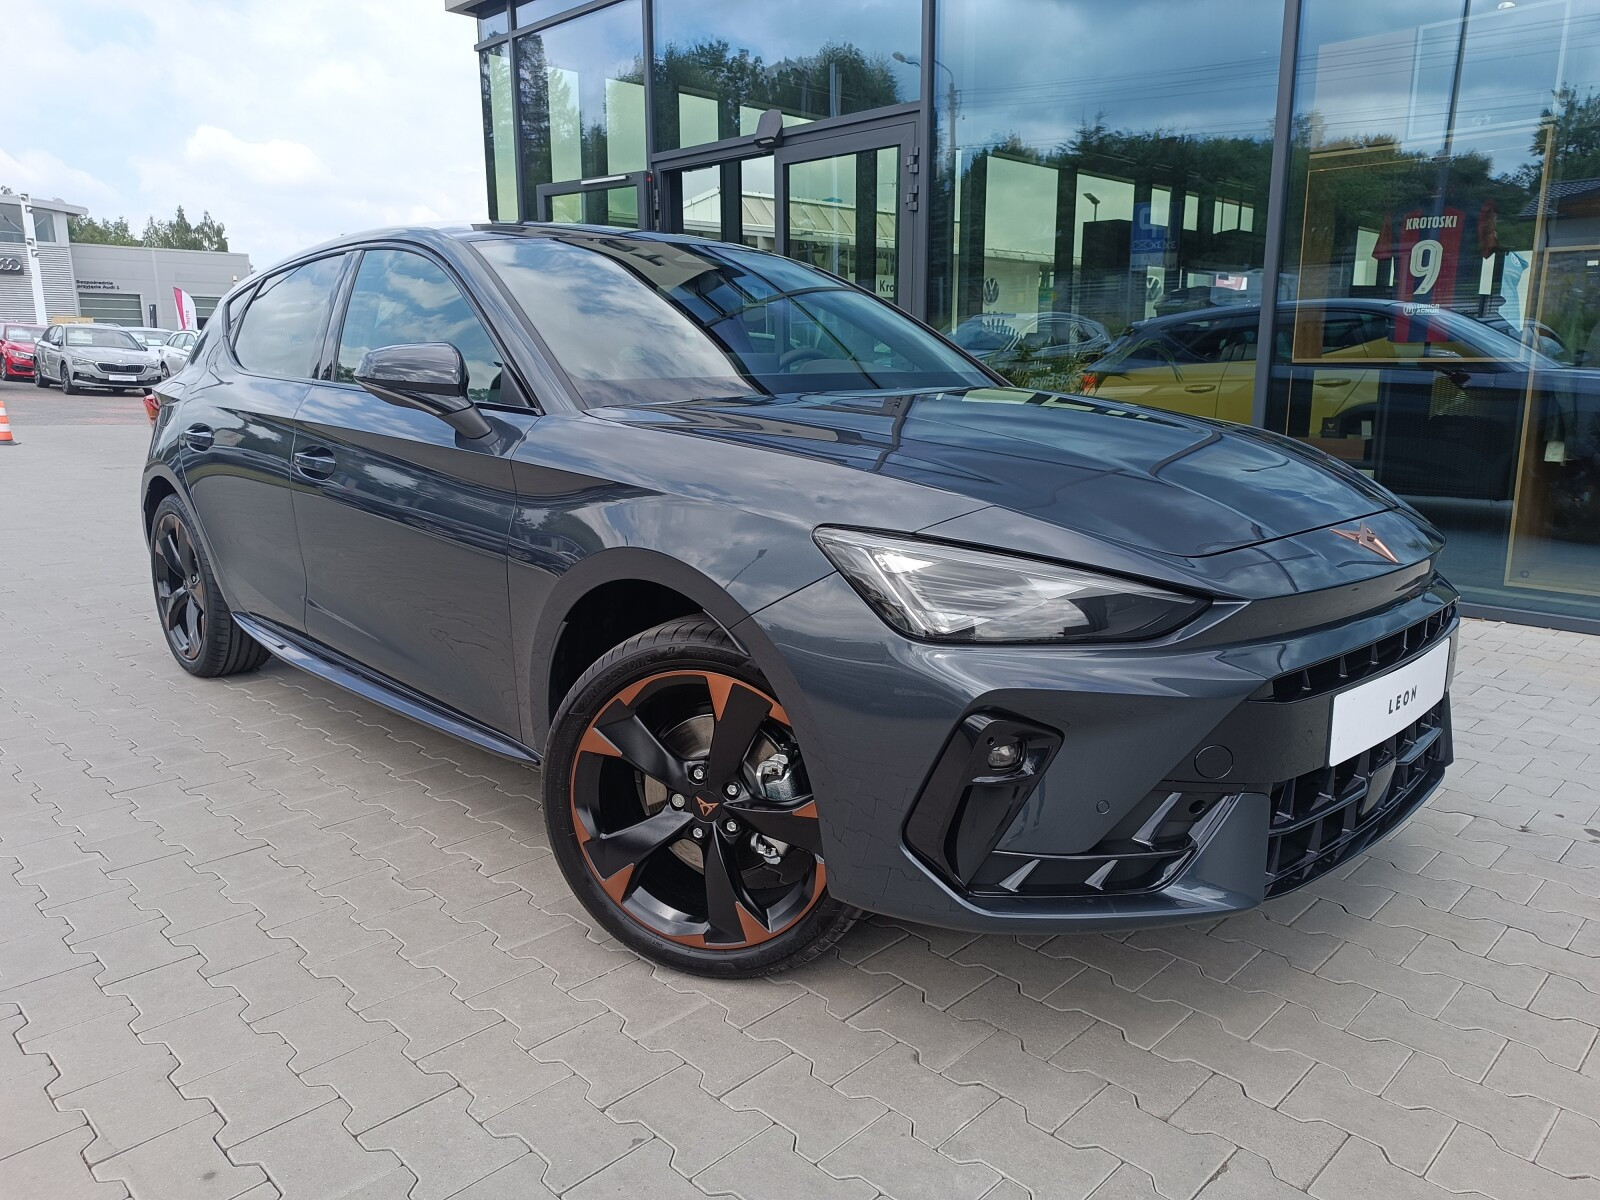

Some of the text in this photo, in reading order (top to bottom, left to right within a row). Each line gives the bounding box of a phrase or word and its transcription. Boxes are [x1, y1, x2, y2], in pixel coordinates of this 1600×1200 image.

[1406, 216, 1457, 230] KROTOSKI
[1409, 239, 1444, 295] 9
[1388, 685, 1418, 715] LEON
